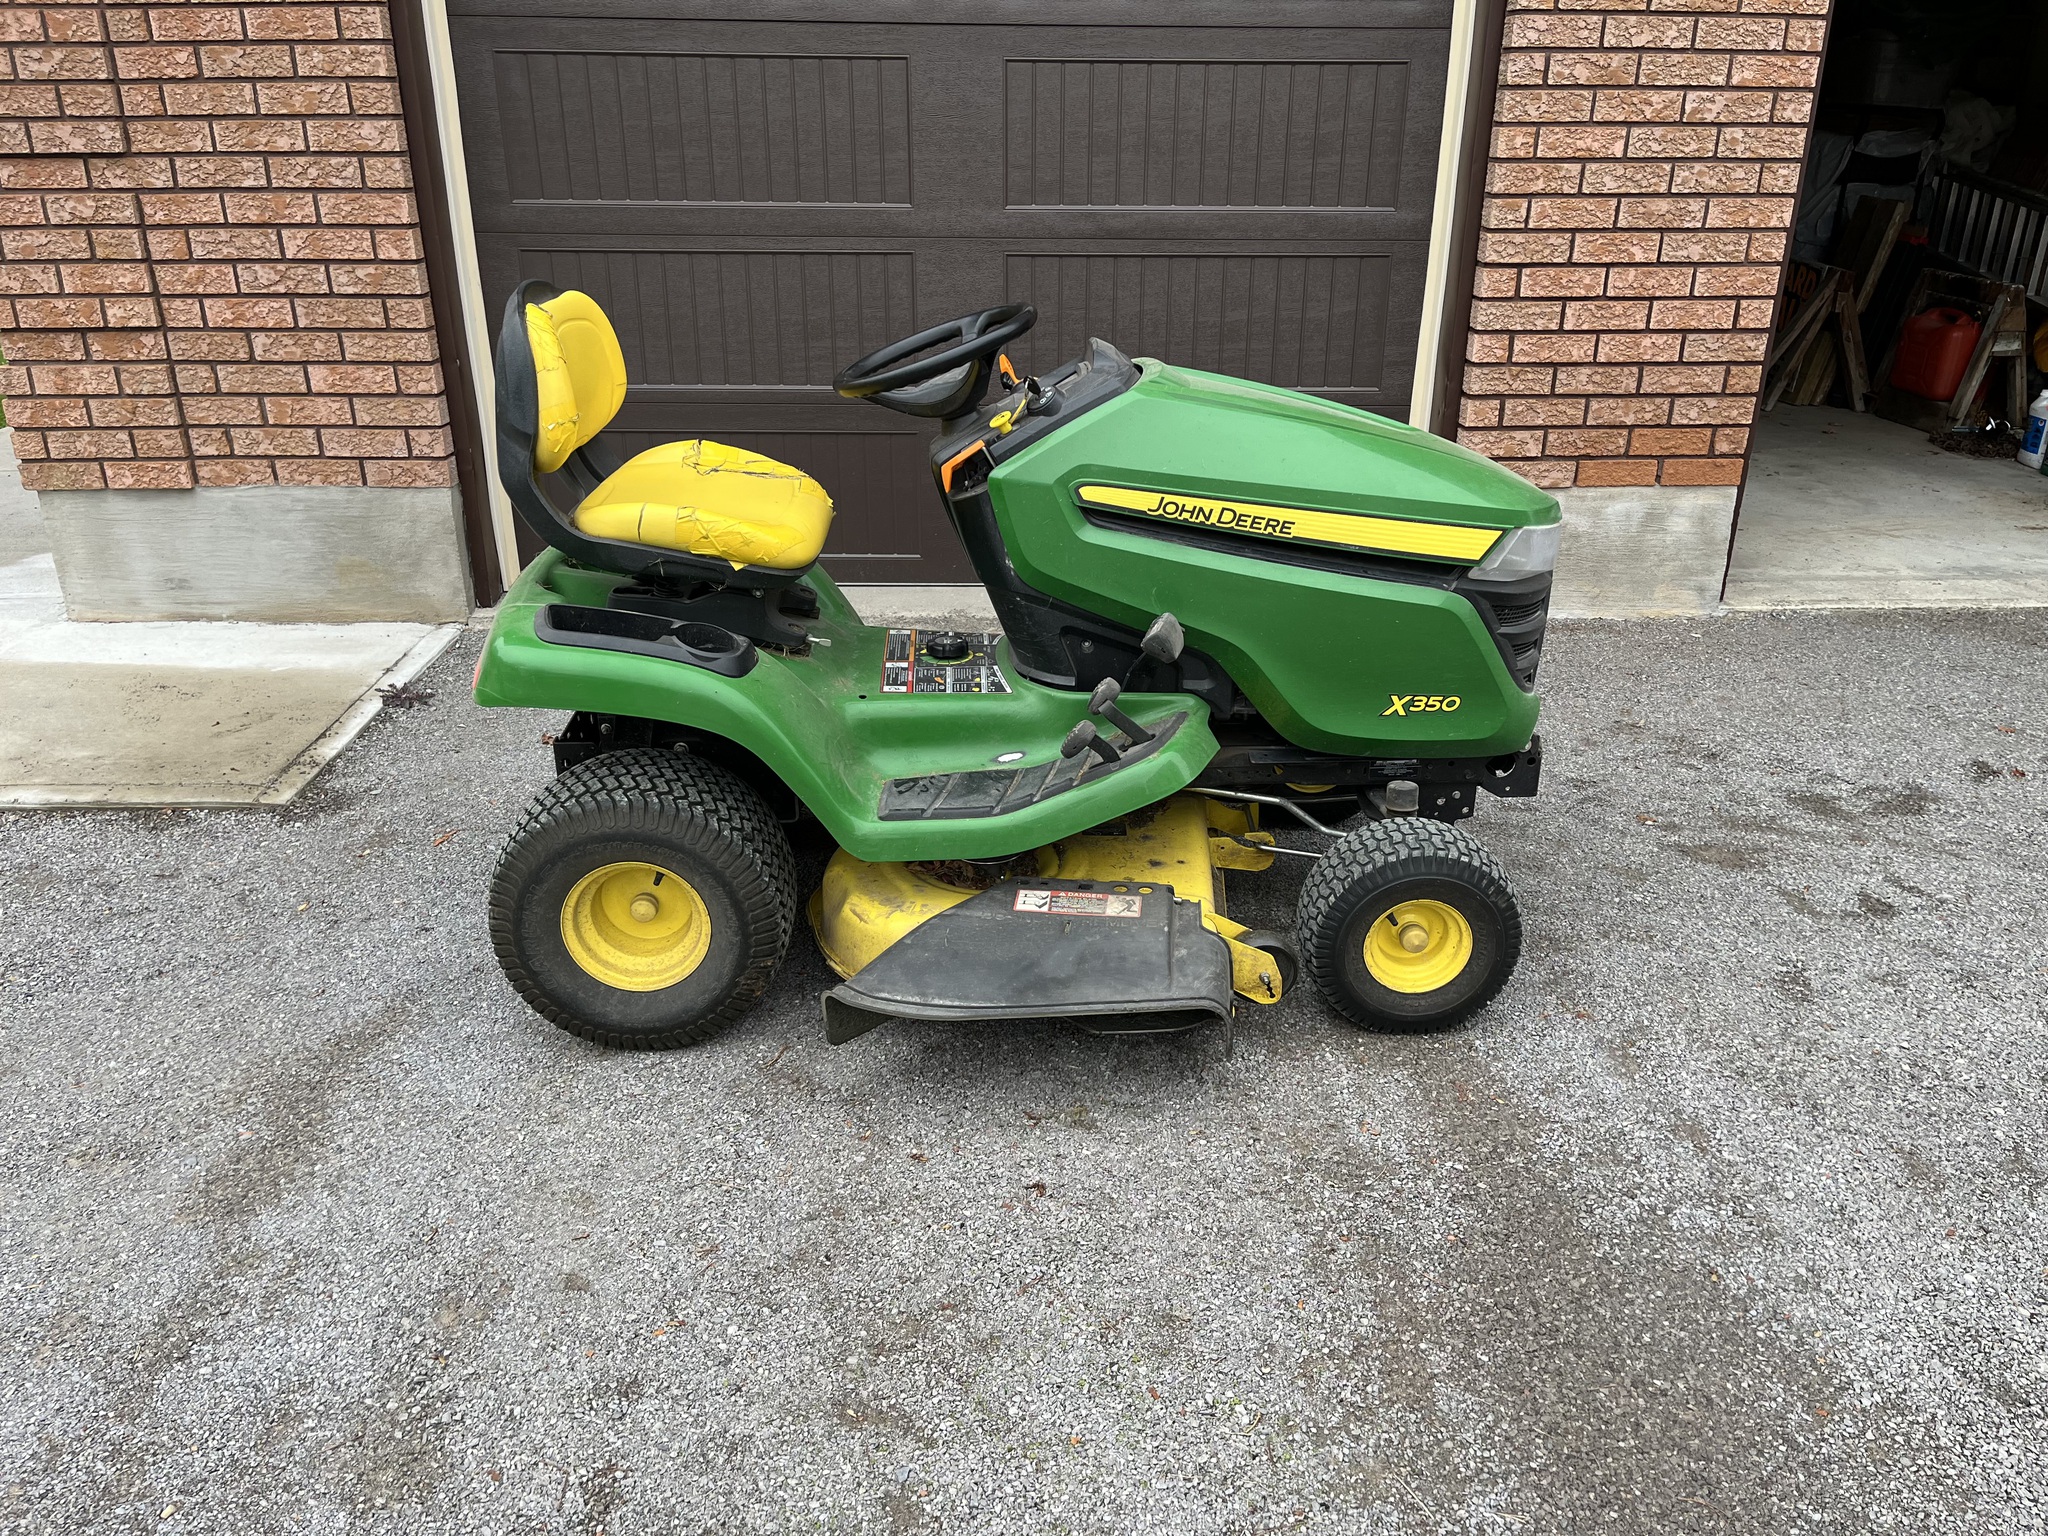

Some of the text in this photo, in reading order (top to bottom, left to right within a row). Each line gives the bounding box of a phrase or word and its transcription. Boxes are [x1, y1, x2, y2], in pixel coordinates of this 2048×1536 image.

[1786, 262, 1817, 300] ARD
[1147, 496, 1296, 535] JOHN DEERE
[1380, 694, 1461, 716] X350
[1067, 891, 1103, 899] DANGER
